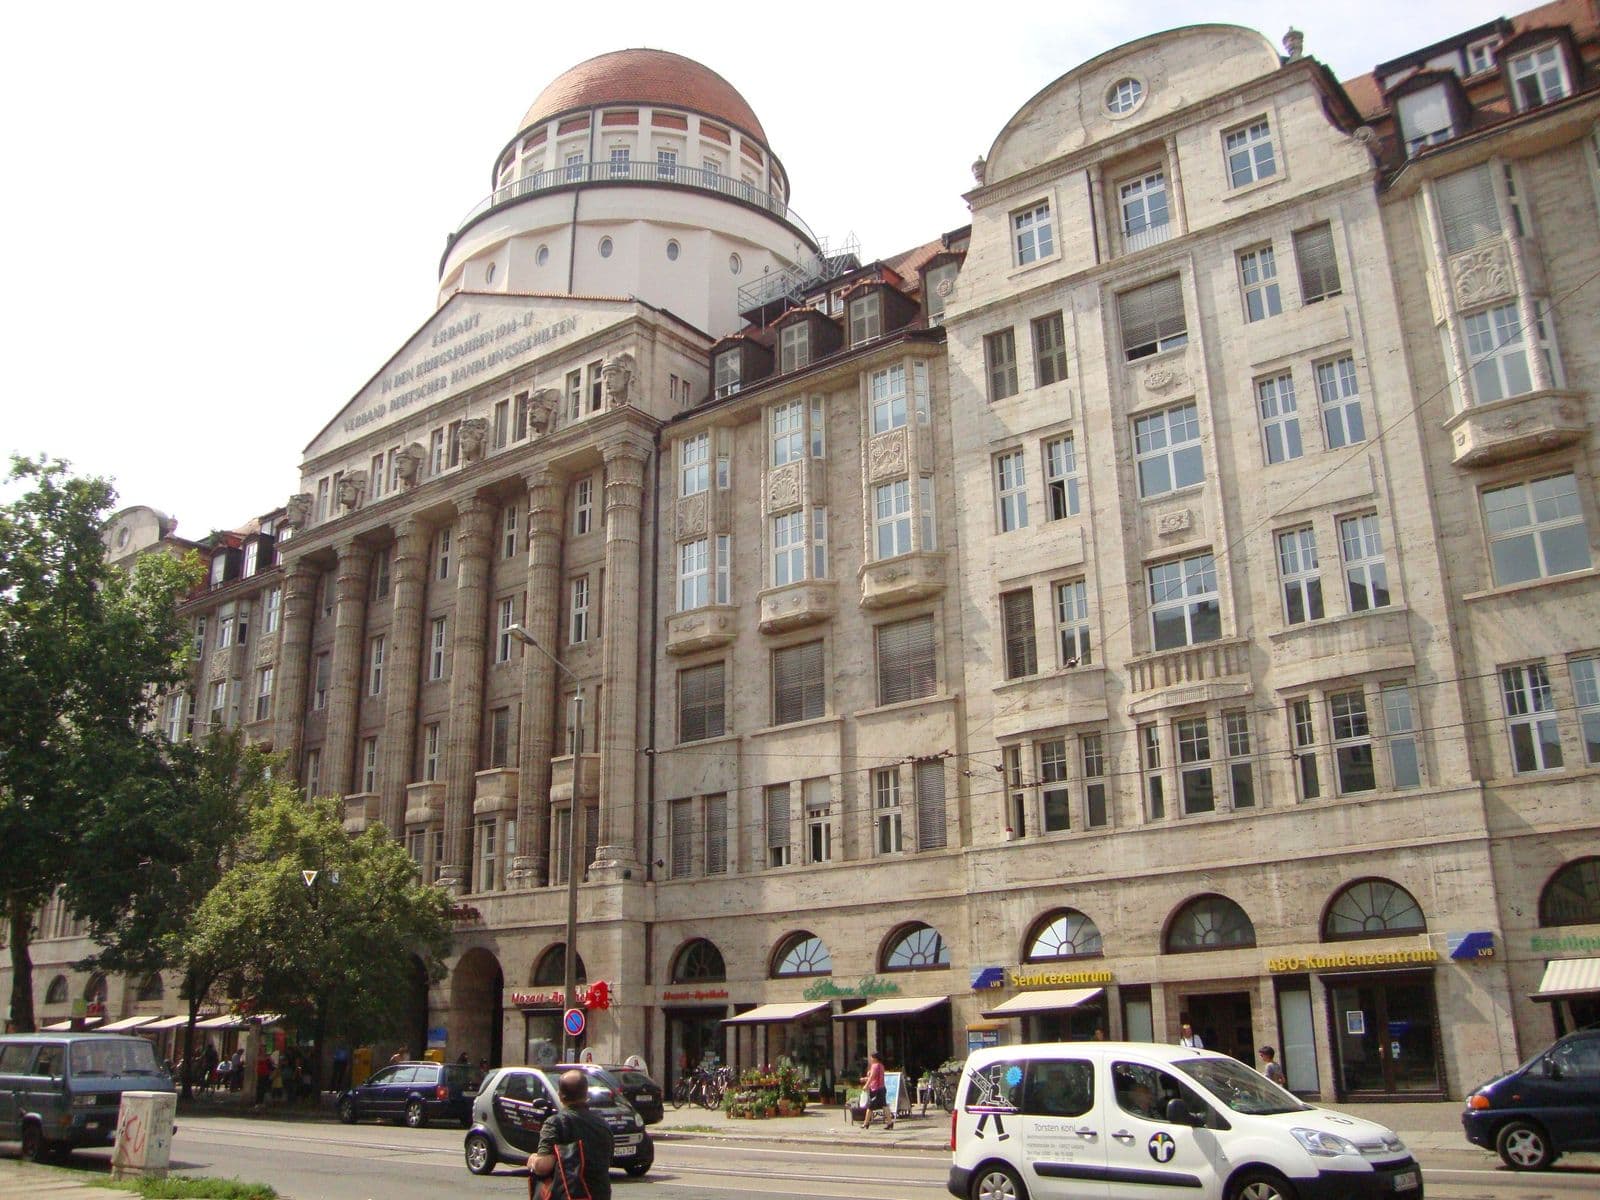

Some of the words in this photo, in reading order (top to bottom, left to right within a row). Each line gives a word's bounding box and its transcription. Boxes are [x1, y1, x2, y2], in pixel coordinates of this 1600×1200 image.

[432, 312, 480, 348] ERBAUT
[393, 367, 415, 388] DEN
[390, 375, 448, 412] DEUTSCHER
[1266, 949, 1439, 972] ABO-Kundenzentrum
[1478, 948, 1494, 956] LVB
[1011, 970, 1112, 987] Servicezentrum
[1034, 1122, 1059, 1132] Torsten
